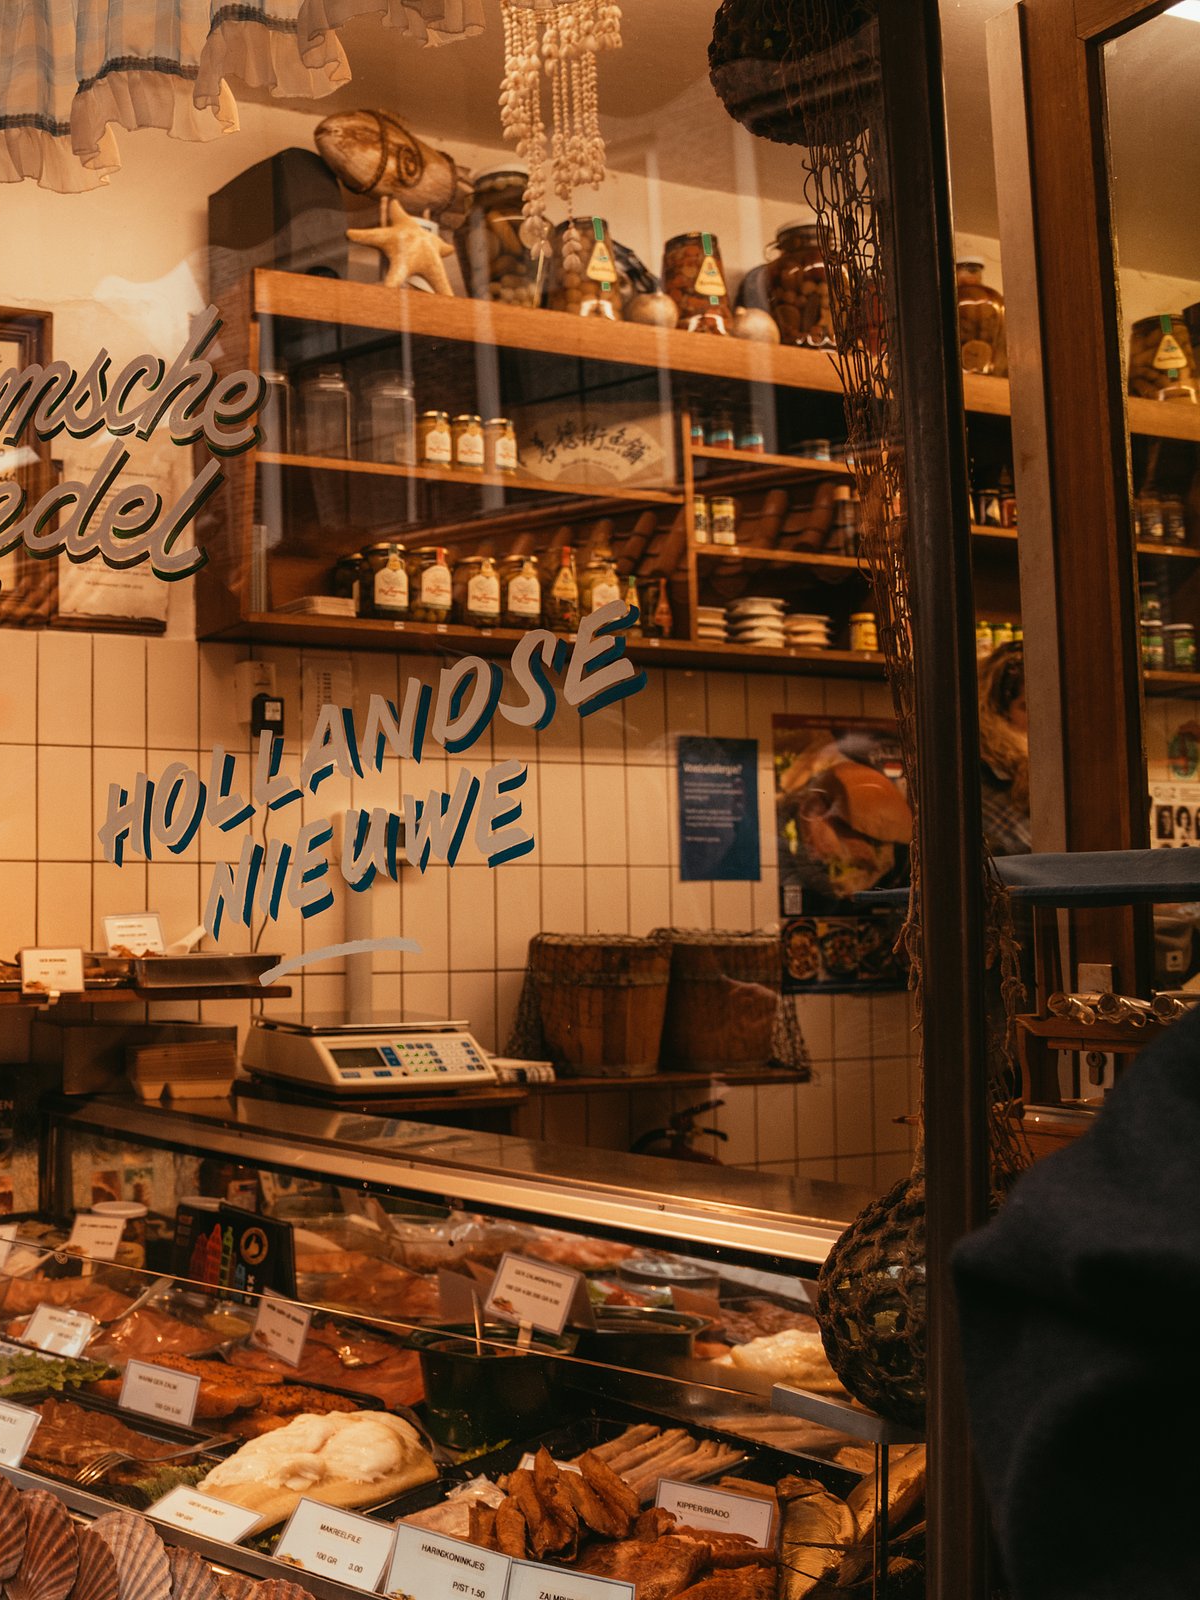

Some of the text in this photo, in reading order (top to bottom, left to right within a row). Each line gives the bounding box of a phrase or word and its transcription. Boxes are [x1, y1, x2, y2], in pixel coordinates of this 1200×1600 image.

[98, 599, 648, 868] HOLLANDSE
[204, 758, 536, 942] NIEUWE
[676, 1500, 730, 1519] KIPPER/BRADO
[319, 1523, 363, 1545] MAKREELFILE
[316, 1551, 364, 1574] 100 GR 3.00
[421, 1543, 486, 1572] HARINGKONINKJES
[452, 1581, 486, 1599] P/ST 1.50
